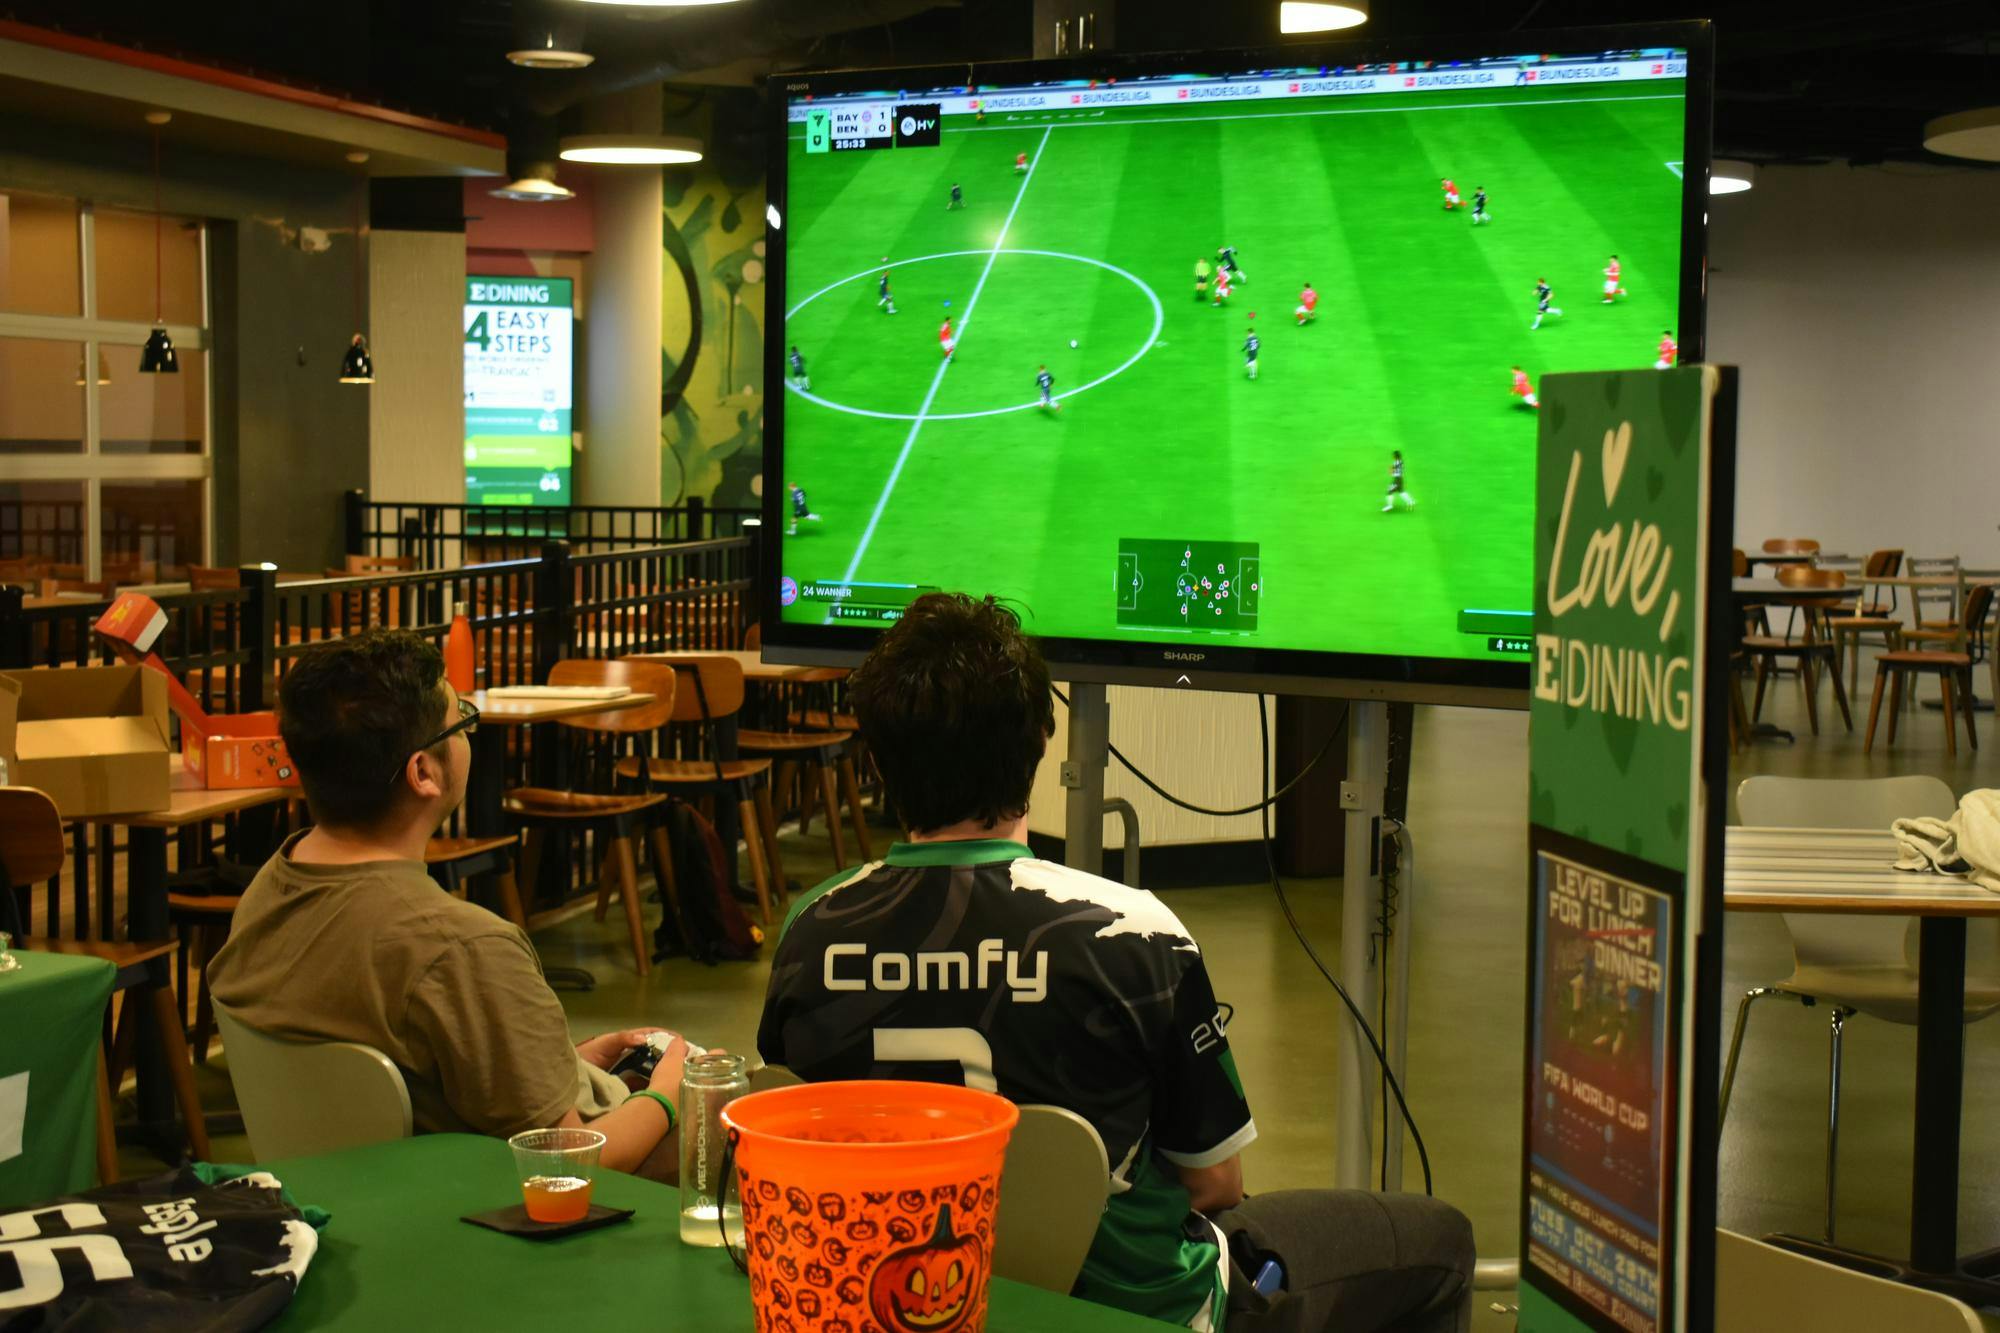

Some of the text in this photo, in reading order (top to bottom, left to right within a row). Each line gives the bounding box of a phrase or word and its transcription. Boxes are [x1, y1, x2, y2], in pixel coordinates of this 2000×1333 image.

[1417, 73, 1495, 87] BUNDESLIGA
[1539, 66, 1619, 81] BUNDESLIGA
[786, 83, 809, 91] AQUOS
[1190, 85, 1261, 98] BUNDESLIGA
[1302, 79, 1376, 93] BUNDESLIGA
[1083, 91, 1151, 104] BUNDESLIGA
[837, 113, 859, 122] BAY
[836, 125, 858, 133] BEN
[465, 311, 549, 352] 4 EASY
[495, 334, 551, 353] STEPS
[803, 586, 814, 597] 24
[1163, 651, 1205, 662] SHARP
[1555, 864, 1646, 919] LEVEL UP
[1549, 890, 1583, 929] FOR
[822, 938, 1049, 1003] Comfy
[1594, 940, 1662, 993] DINNER
[1543, 1061, 1648, 1131] FIFA WORLD CUP
